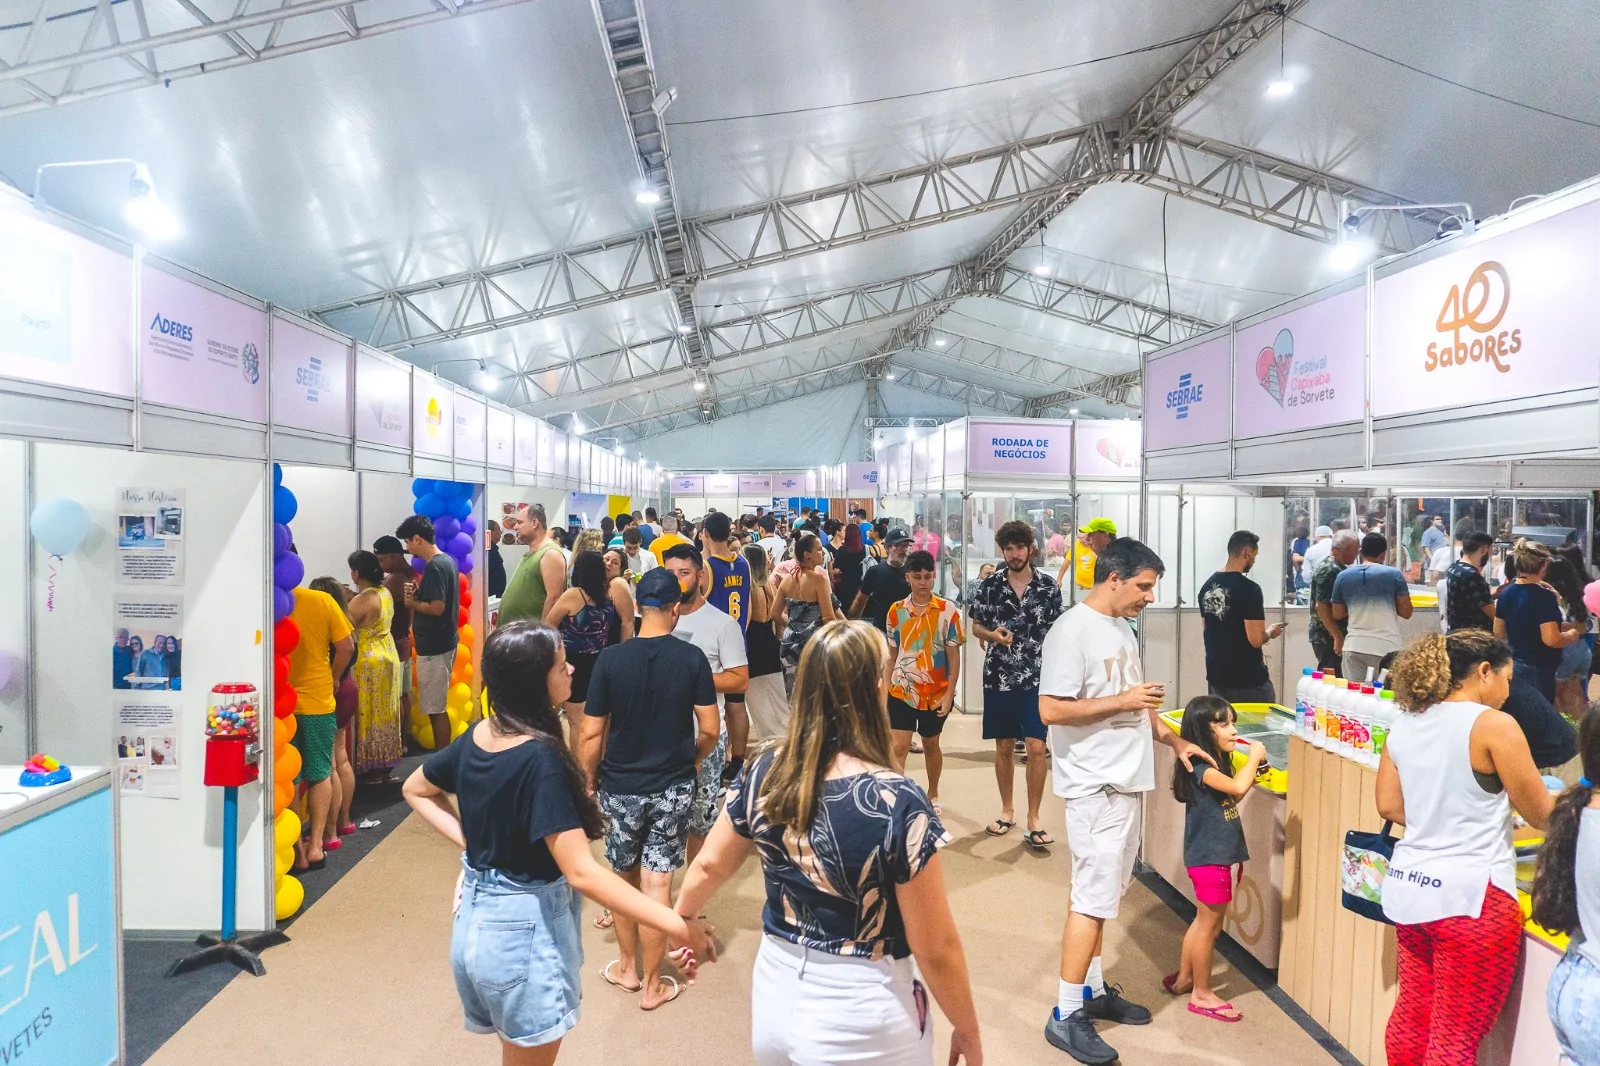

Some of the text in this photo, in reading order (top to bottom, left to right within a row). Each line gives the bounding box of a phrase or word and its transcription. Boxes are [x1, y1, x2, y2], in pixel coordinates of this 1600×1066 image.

[1436, 260, 1510, 333] 40
[150, 312, 193, 342] ADERES
[1294, 354, 1327, 375] Festival
[1291, 372, 1331, 393] Capixaba
[1166, 384, 1204, 409] SEBRAE
[1287, 387, 1335, 407] de Sorvete
[991, 438, 1049, 448] RODADA DE
[994, 448, 1046, 459] NEGÓCIOS
[724, 574, 743, 588] JAMES
[728, 591, 740, 621] 6
[1387, 867, 1443, 888] am Hipo
[0, 1006, 53, 1066] VETES
